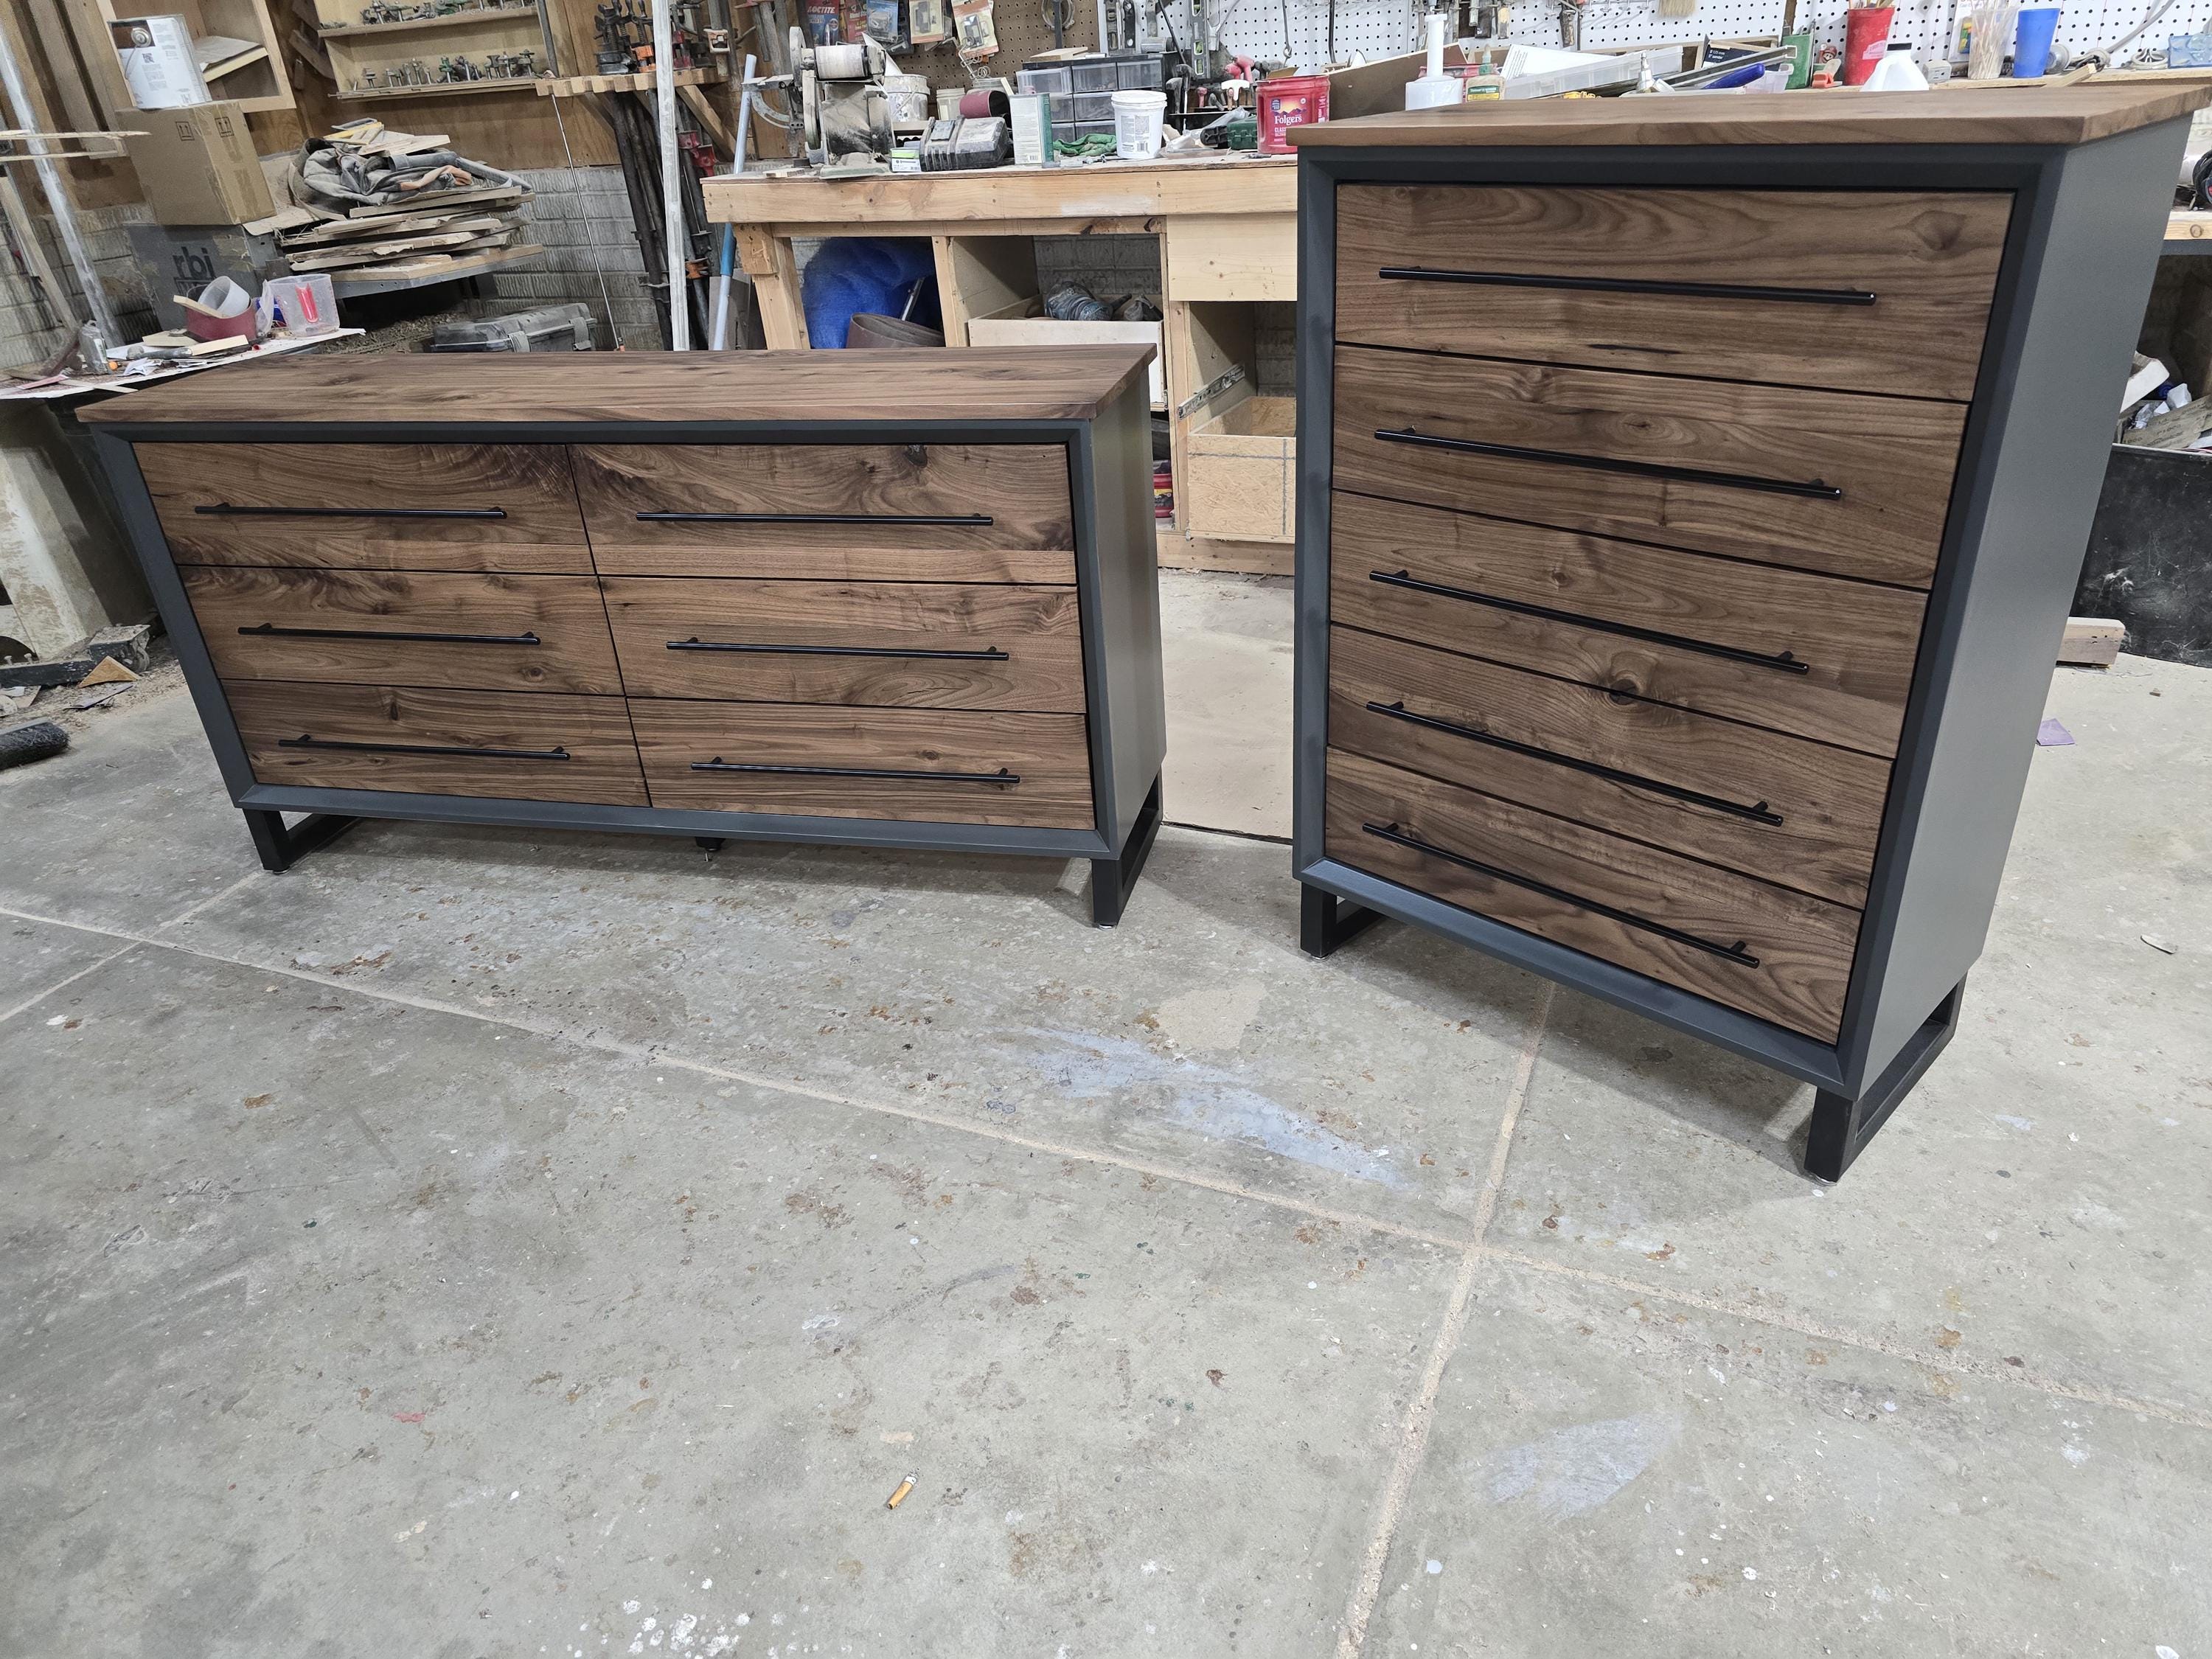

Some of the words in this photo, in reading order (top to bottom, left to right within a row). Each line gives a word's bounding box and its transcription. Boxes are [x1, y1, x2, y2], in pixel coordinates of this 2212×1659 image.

[807, 5, 835, 14] LOCTITE
[1274, 114, 1303, 125] Folgers
[172, 246, 218, 280] rbi
